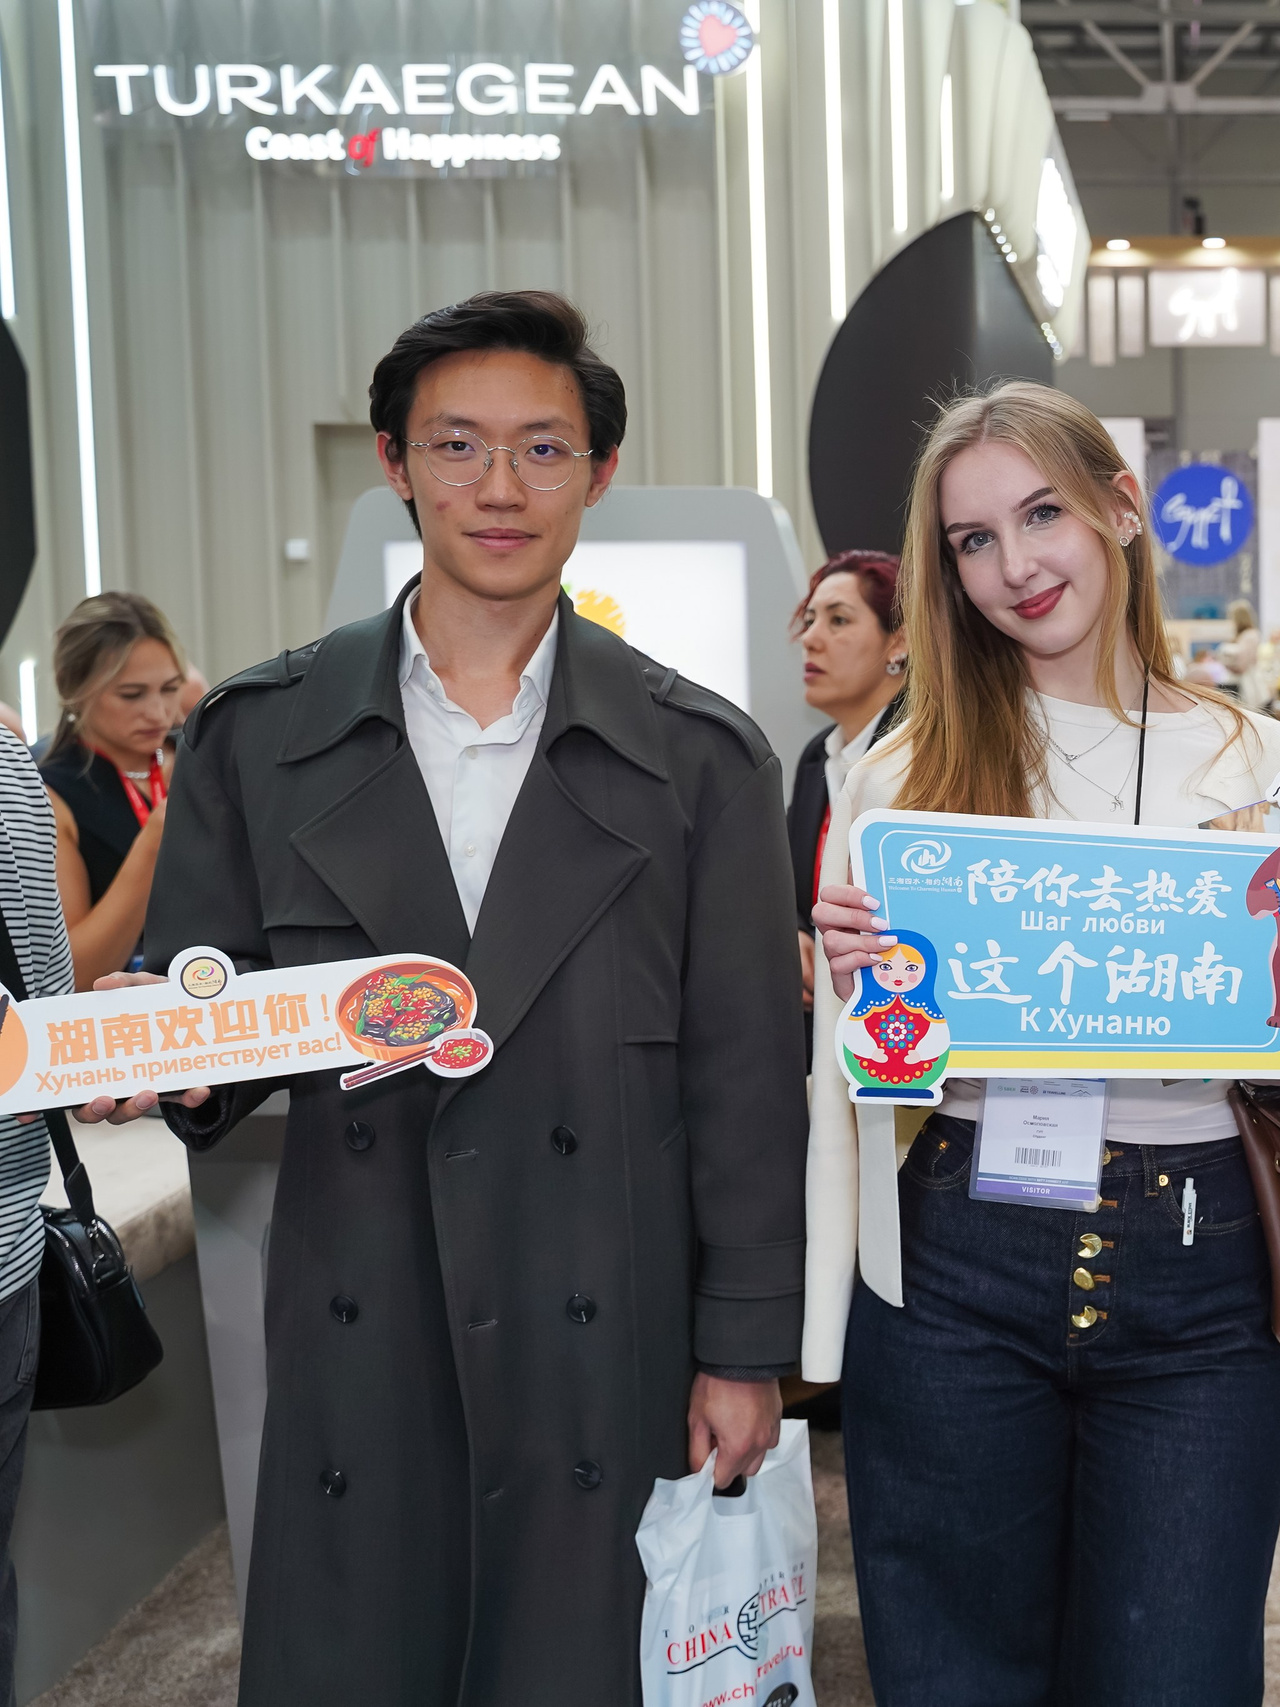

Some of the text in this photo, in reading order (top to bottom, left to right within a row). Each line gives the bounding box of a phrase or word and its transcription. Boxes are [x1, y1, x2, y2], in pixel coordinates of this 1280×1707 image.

[94, 62, 700, 117] TURKAEGEAN
[246, 126, 561, 168] Coast of Happiness
[967, 859, 1233, 918] 陪你去热爱
[1021, 911, 1166, 935] Шаг любви
[947, 939, 1243, 1006] 这个湖南
[1020, 1007, 1171, 1040] К Хунаню
[35, 1032, 342, 1096] Хунань приветствует вас!
[1021, 1186, 1051, 1195] VISITOR
[662, 1606, 729, 1638] TOR
[667, 1621, 733, 1665] CHINA
